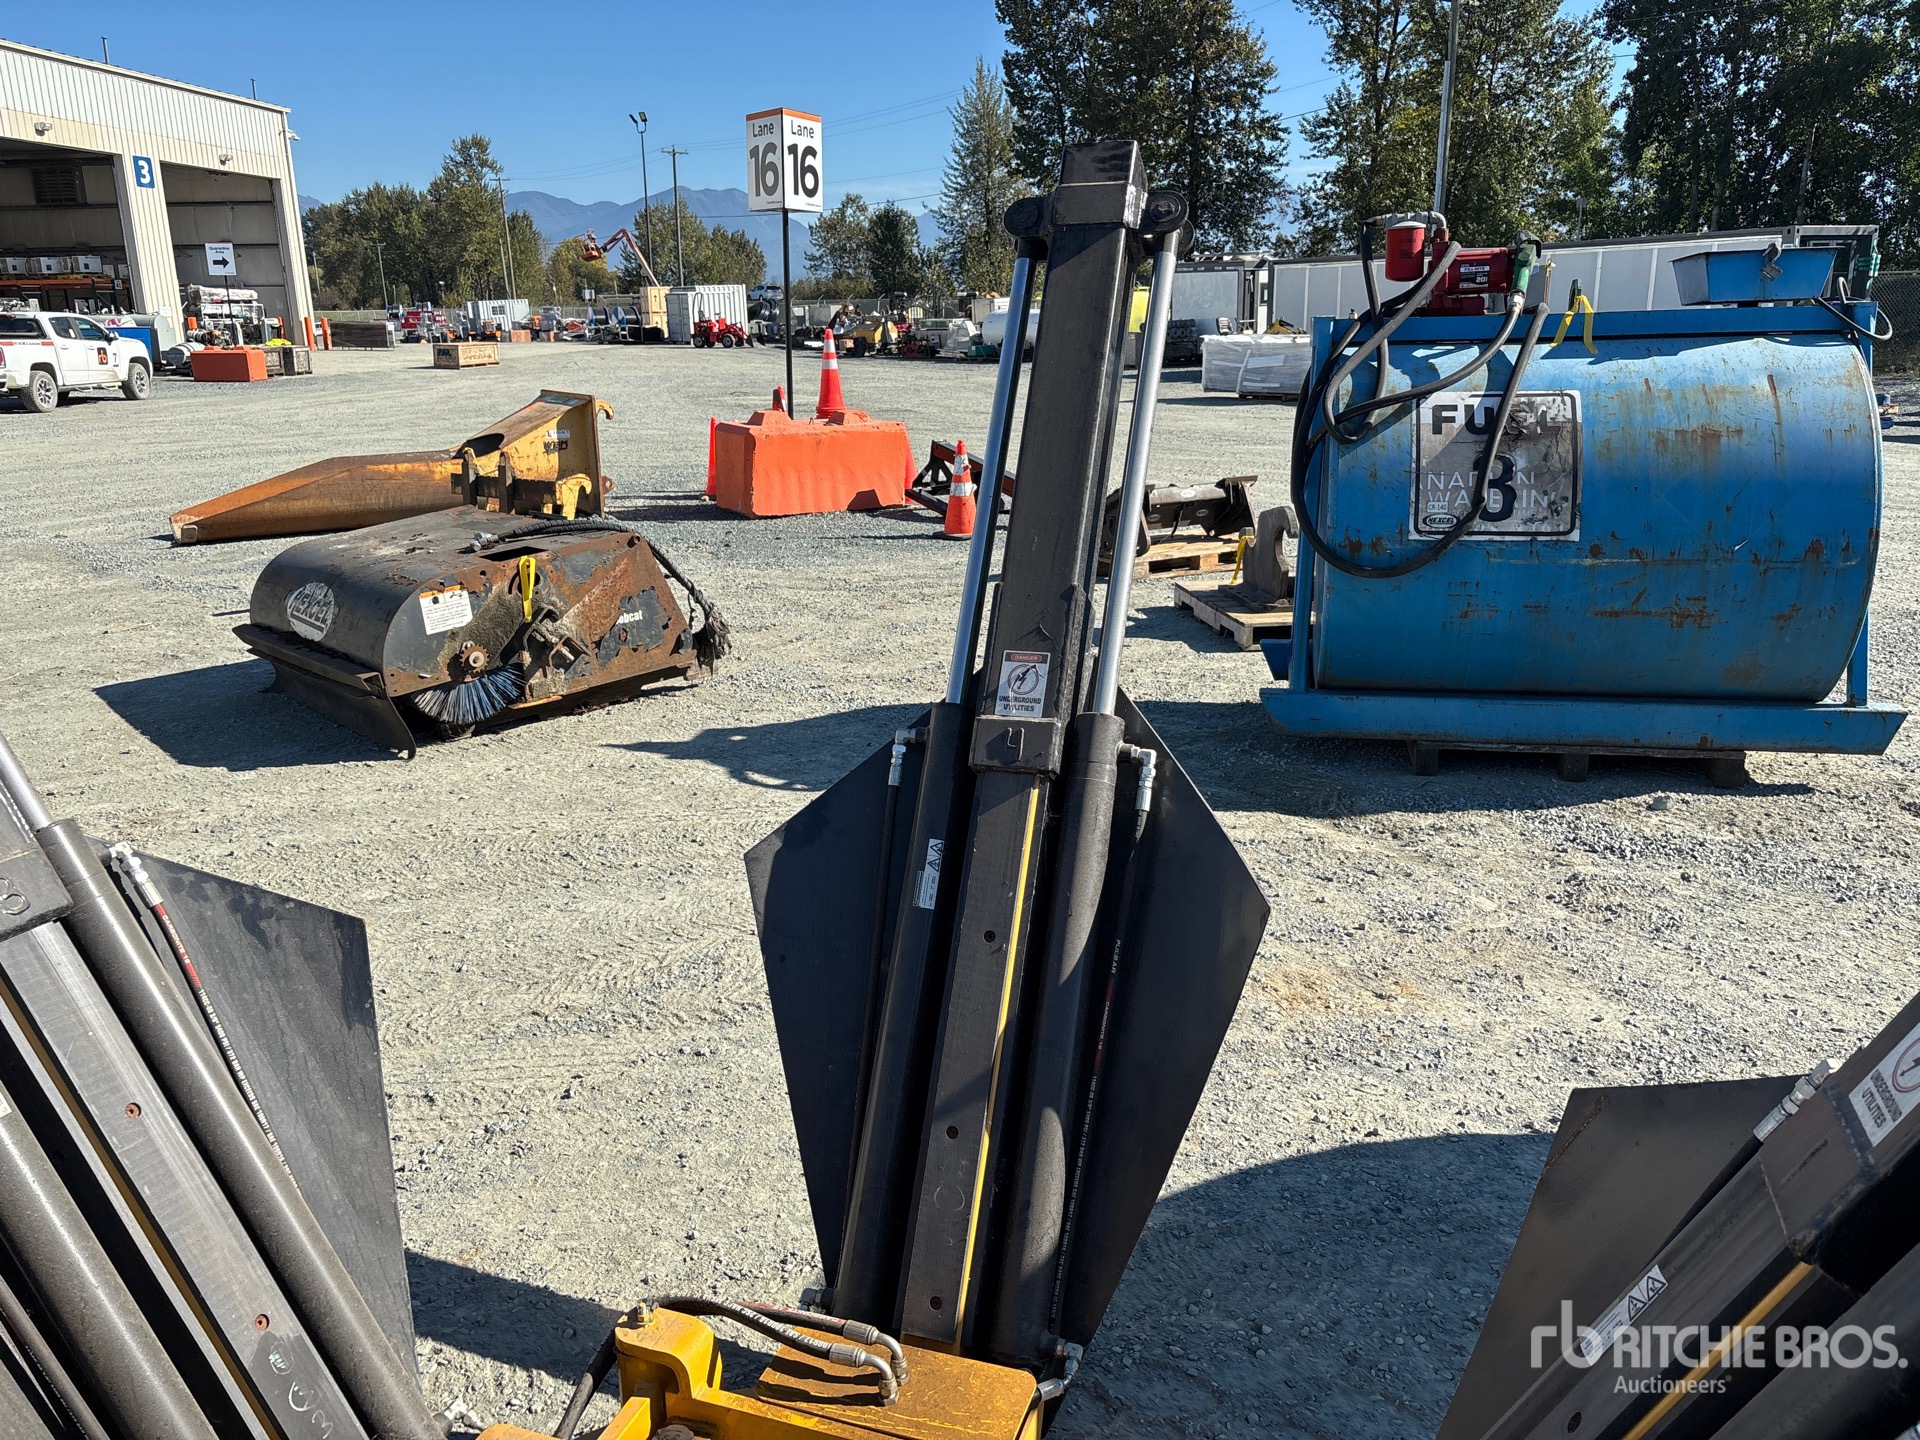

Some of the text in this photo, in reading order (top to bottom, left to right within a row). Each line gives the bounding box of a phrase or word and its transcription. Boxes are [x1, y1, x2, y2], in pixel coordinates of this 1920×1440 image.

[752, 122, 774, 138] Lane
[790, 119, 815, 139] Lane
[137, 160, 151, 184] 3
[749, 142, 780, 197] 16
[787, 143, 820, 198] 16
[1431, 404, 1562, 436] FUL
[1427, 517, 1456, 525] HEXCEL
[616, 609, 643, 625] obcat
[999, 695, 1042, 705] UNDERGROUND
[1003, 704, 1035, 712] UTILITIES
[161, 913, 186, 954] CARBONITE
[1109, 939, 1121, 973] PULSAR
[1098, 1001, 1110, 1038] CARBONITE
[1862, 1087, 1887, 1128] UTILITIES
[1870, 1068, 1903, 1123] UNDERGROUND
